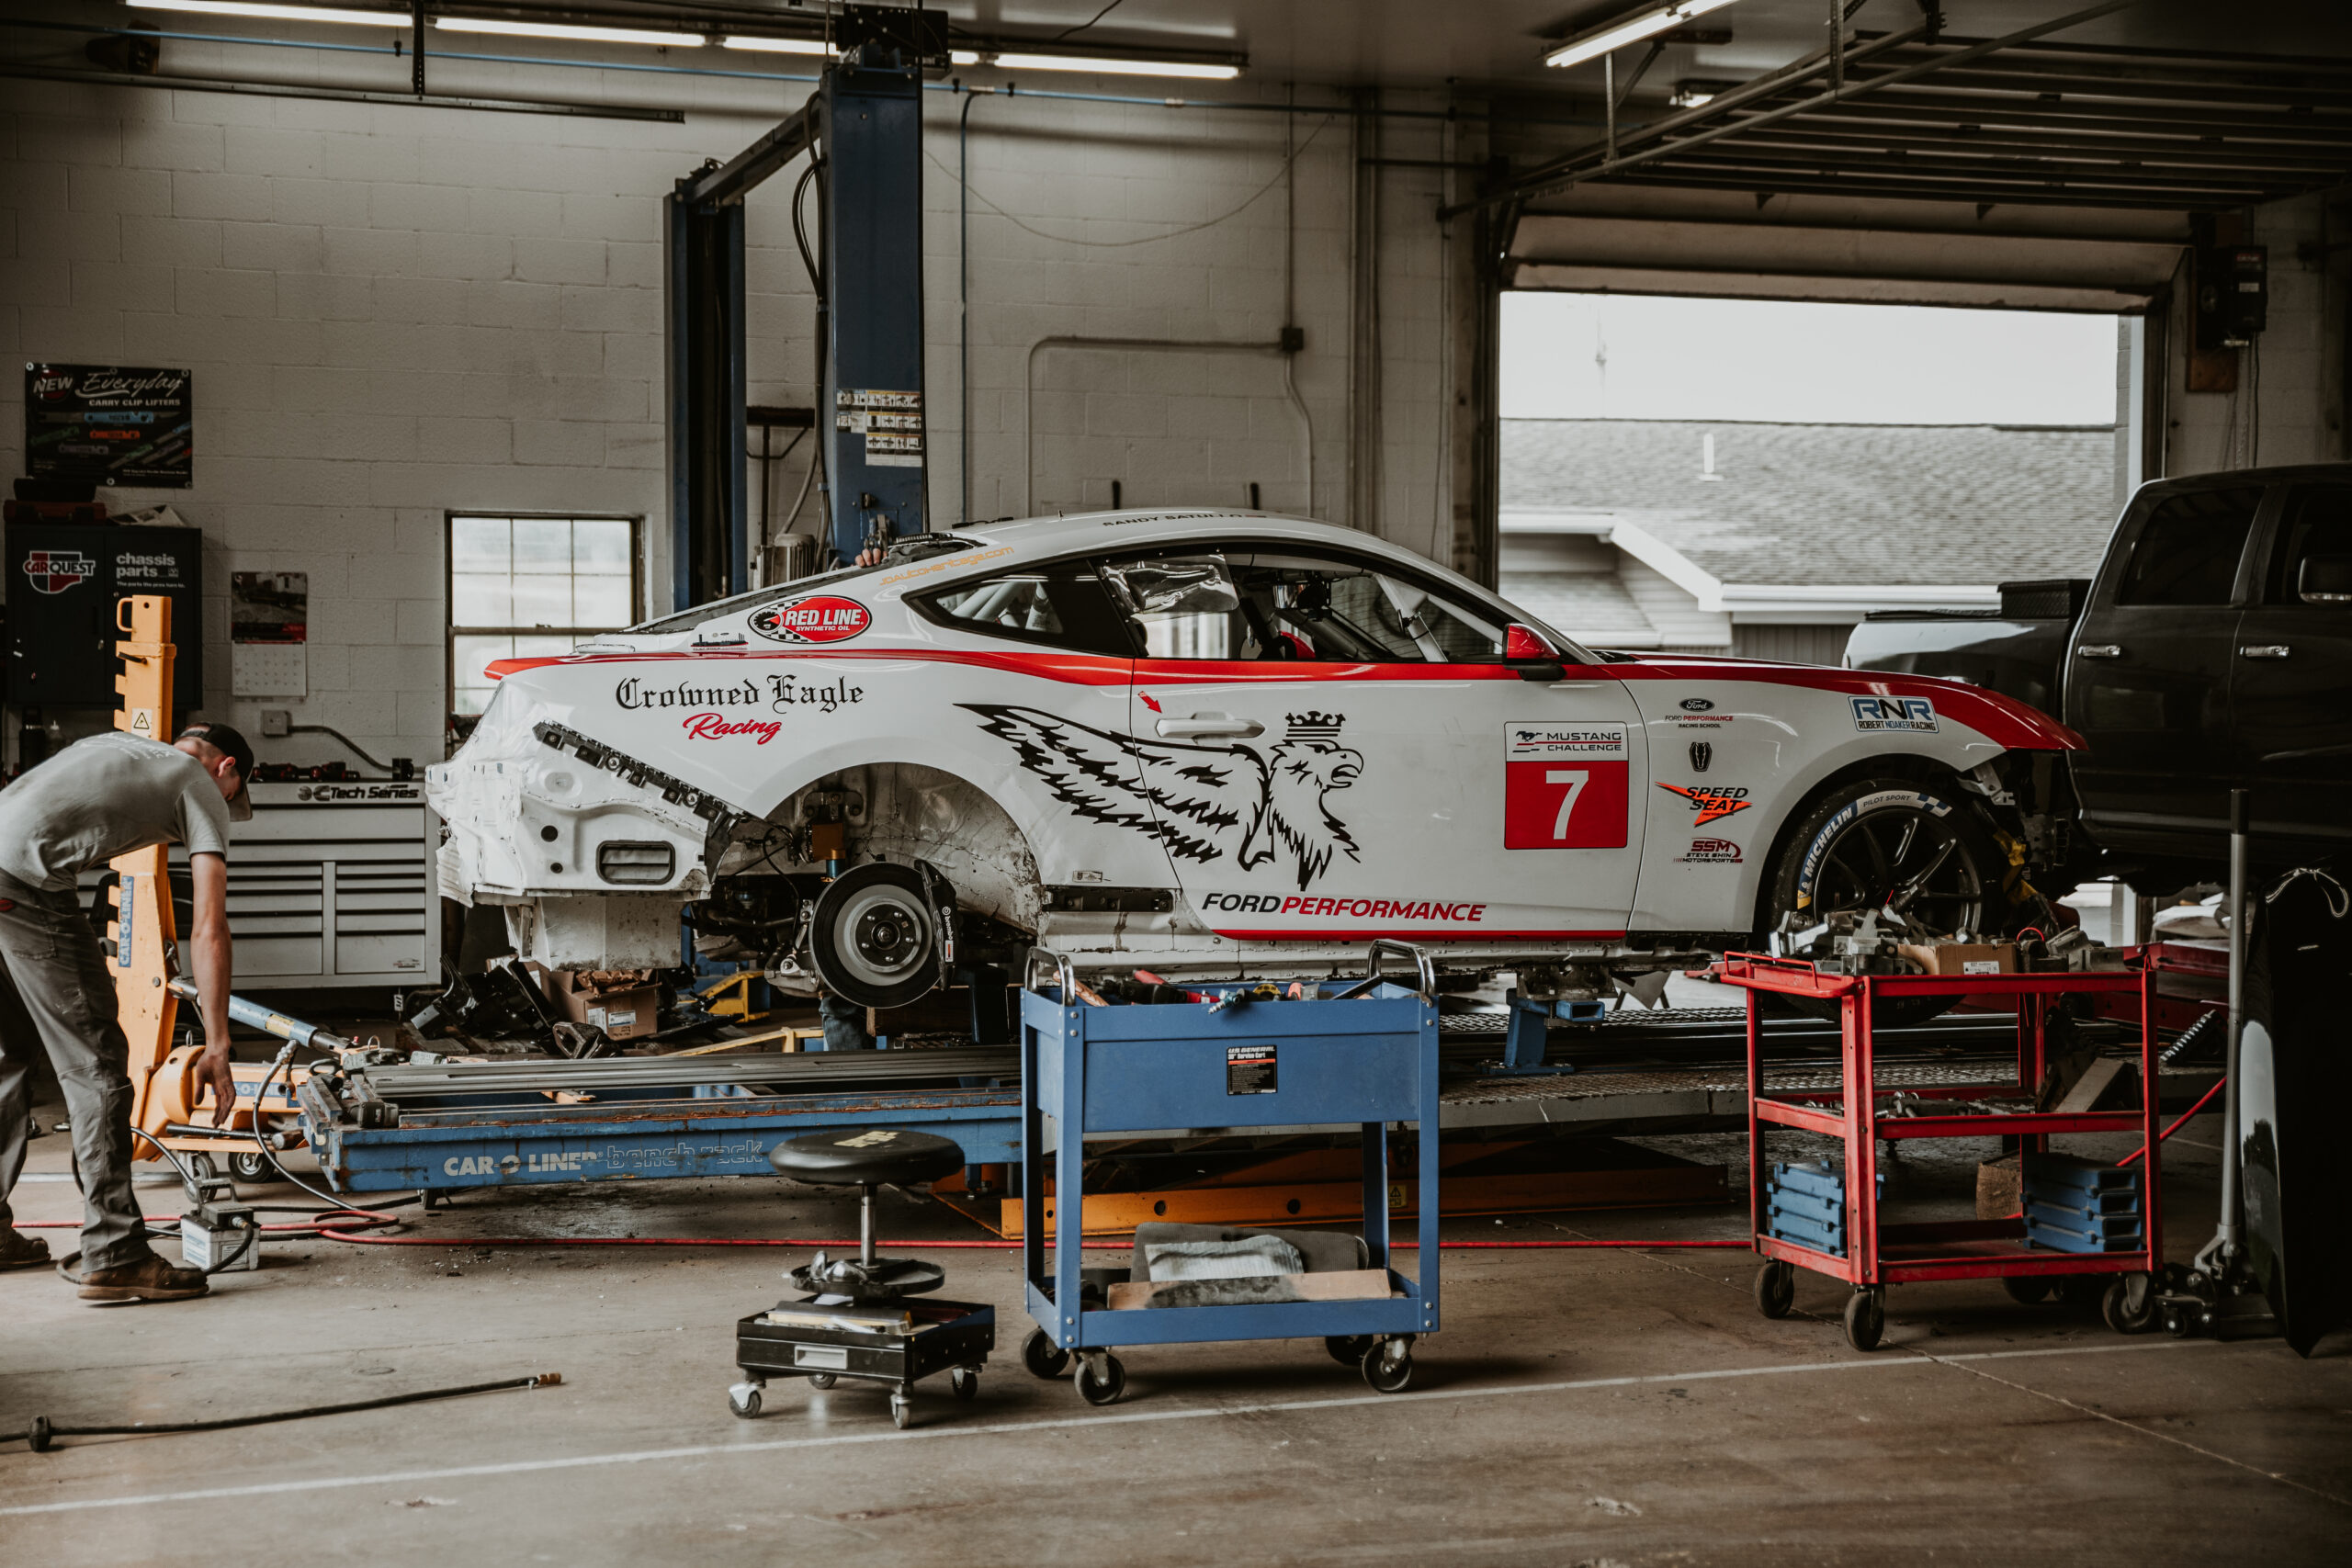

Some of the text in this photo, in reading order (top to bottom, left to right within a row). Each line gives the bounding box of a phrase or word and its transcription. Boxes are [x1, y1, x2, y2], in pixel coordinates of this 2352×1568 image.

[33, 371, 184, 397] NEW Everyday
[1102, 516, 1159, 526] SANDY
[116, 553, 175, 566] chassis
[24, 561, 95, 576] CARQUEST
[116, 566, 158, 579] parts
[785, 609, 863, 626] RED LINE
[616, 674, 864, 715] Crowned Eagle
[1686, 700, 1709, 709] Ford
[1852, 698, 1933, 721] RNR
[683, 713, 783, 745] Racing
[1858, 720, 1937, 731] ROBERT NOAKER RACING
[1546, 732, 1623, 741] MUSTANG
[368, 785, 419, 799] Series
[1686, 786, 1749, 799] SPEED
[1545, 770, 1589, 840] 7
[1689, 799, 1743, 811] SEAT
[1863, 796, 1884, 807] PILOT
[1690, 840, 1732, 852] SSM
[1804, 807, 1853, 878] MICHELIN
[944, 916, 954, 941] brembo
